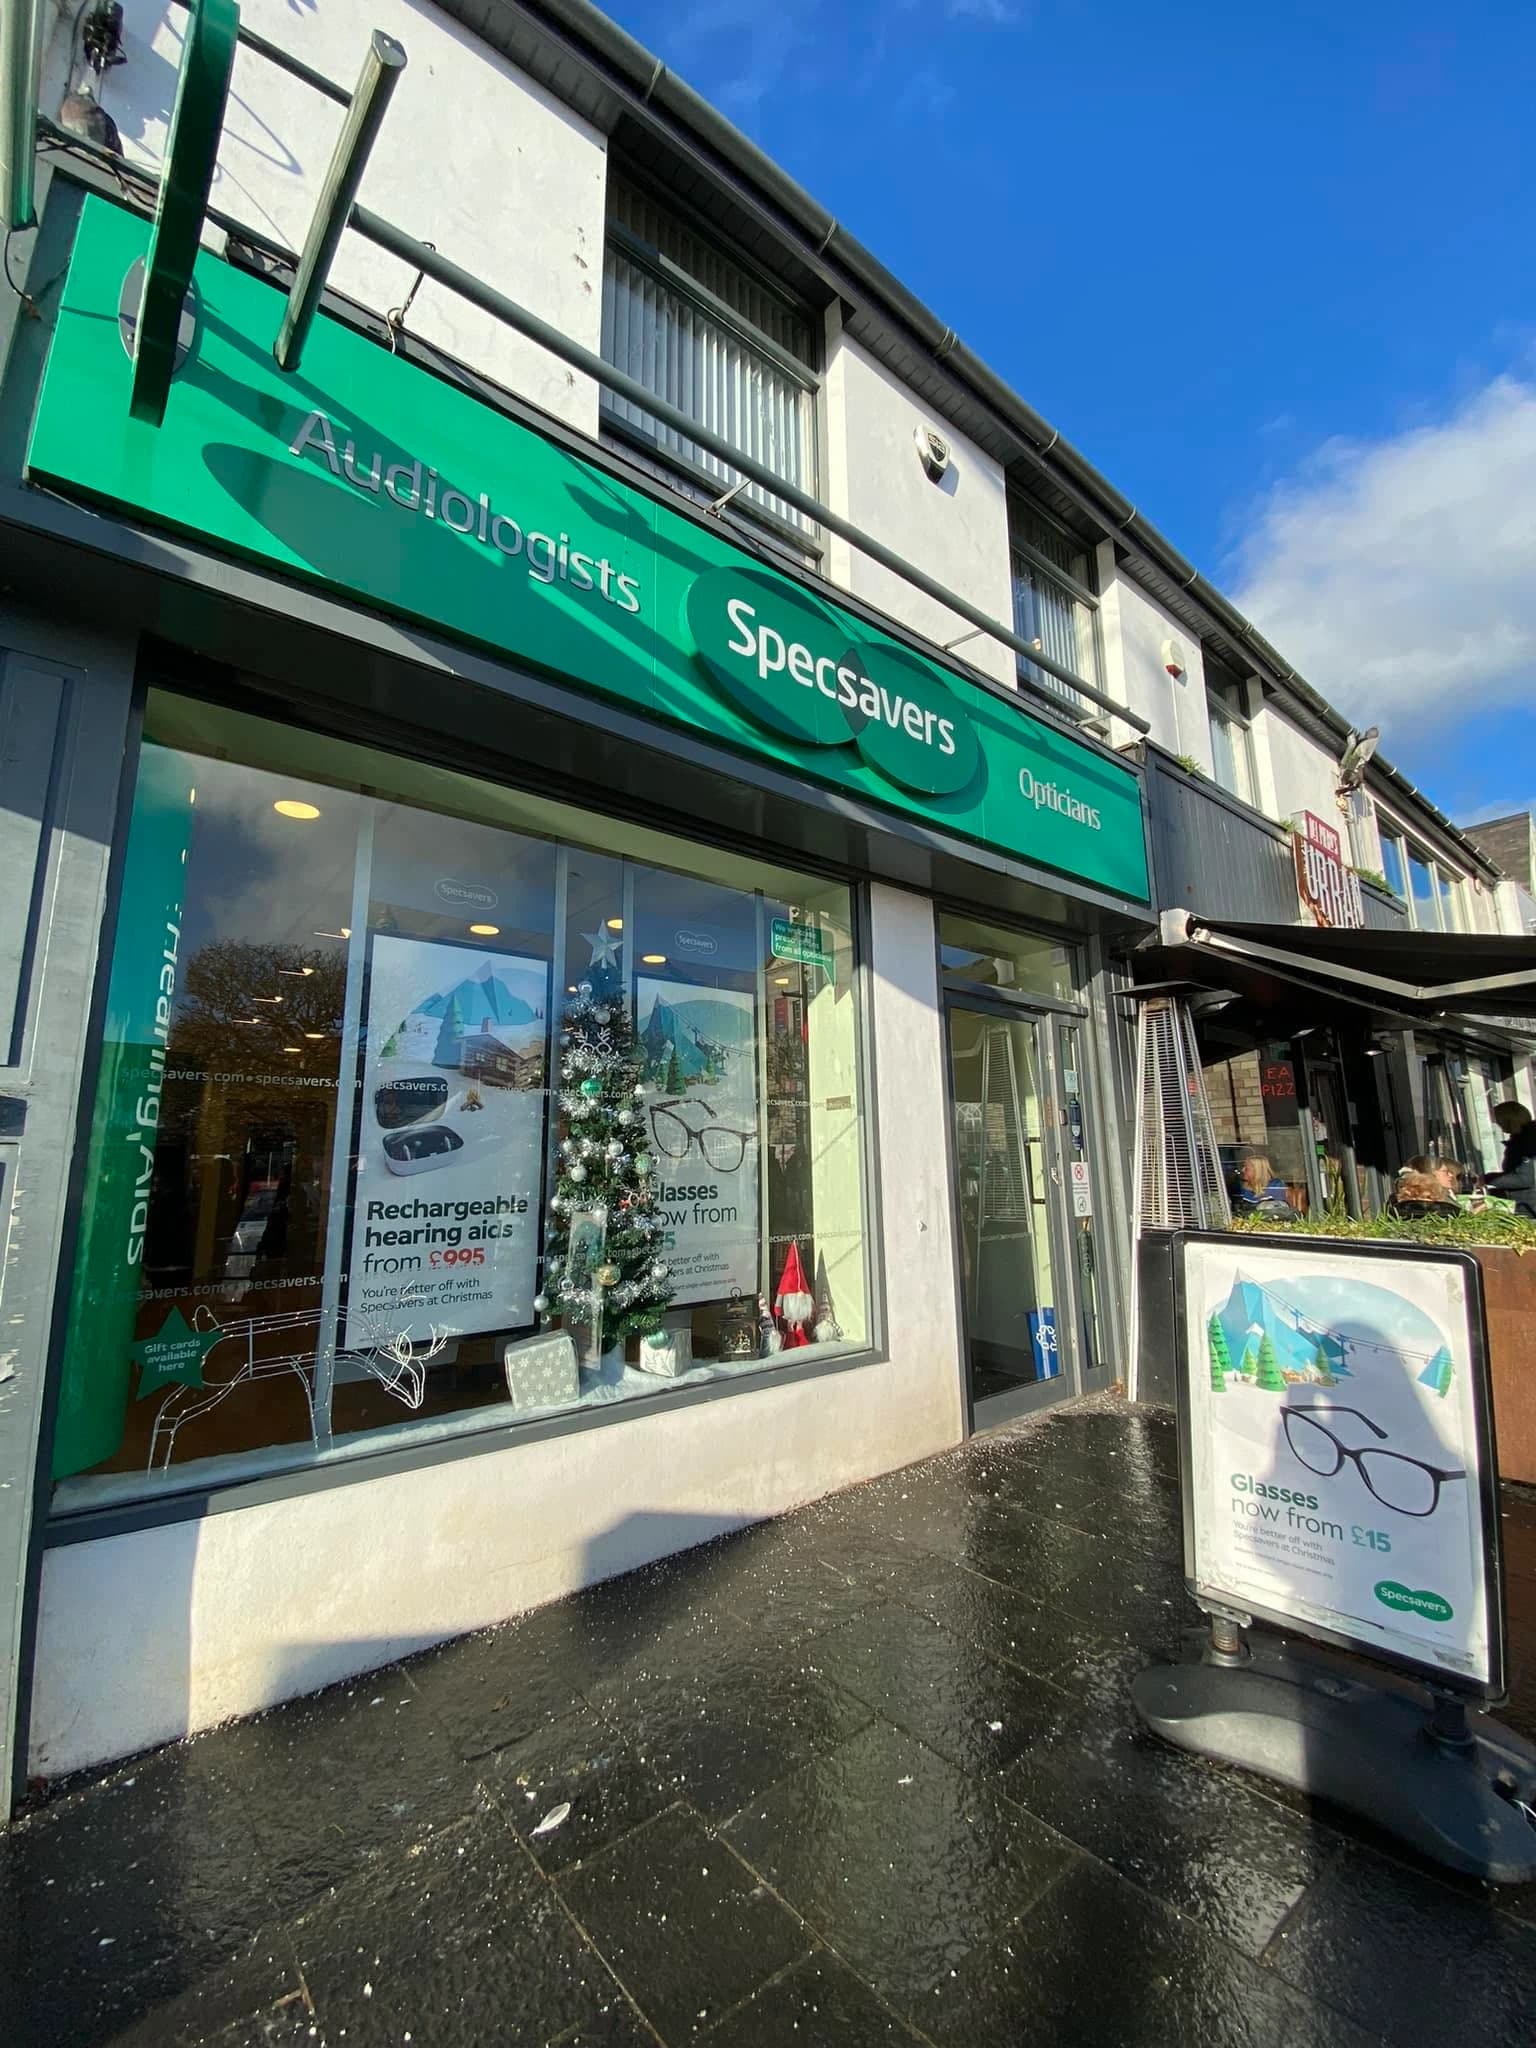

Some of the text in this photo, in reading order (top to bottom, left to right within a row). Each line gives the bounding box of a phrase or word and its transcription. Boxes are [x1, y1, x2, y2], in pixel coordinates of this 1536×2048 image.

[288, 408, 643, 616] Audiologists
[726, 598, 956, 756] Specsavers
[1017, 766, 1102, 832] Opticians
[1266, 1066, 1290, 1080] EA
[1262, 1082, 1296, 1097] PIZZ
[367, 1195, 529, 1222] Rechargeable
[692, 1202, 738, 1225] from
[365, 1219, 514, 1248] hearing aids
[362, 1247, 486, 1274] from £995
[362, 1284, 398, 1300] You're
[438, 1279, 455, 1292] off
[456, 1277, 480, 1290] with
[426, 1296, 439, 1306] at
[440, 1291, 494, 1305] Christmas
[144, 1338, 201, 1355] Gift cards
[147, 1348, 197, 1365] available
[158, 1360, 185, 1373] here
[1230, 1473, 1319, 1511] Glasses
[1232, 1497, 1392, 1553] now from £15
[1259, 1525, 1287, 1541] better
[1288, 1533, 1301, 1545] off
[1302, 1538, 1323, 1552] with
[1281, 1543, 1291, 1553] at
[1291, 1545, 1336, 1567] Christmas
[1380, 1586, 1448, 1614] Specsavers
